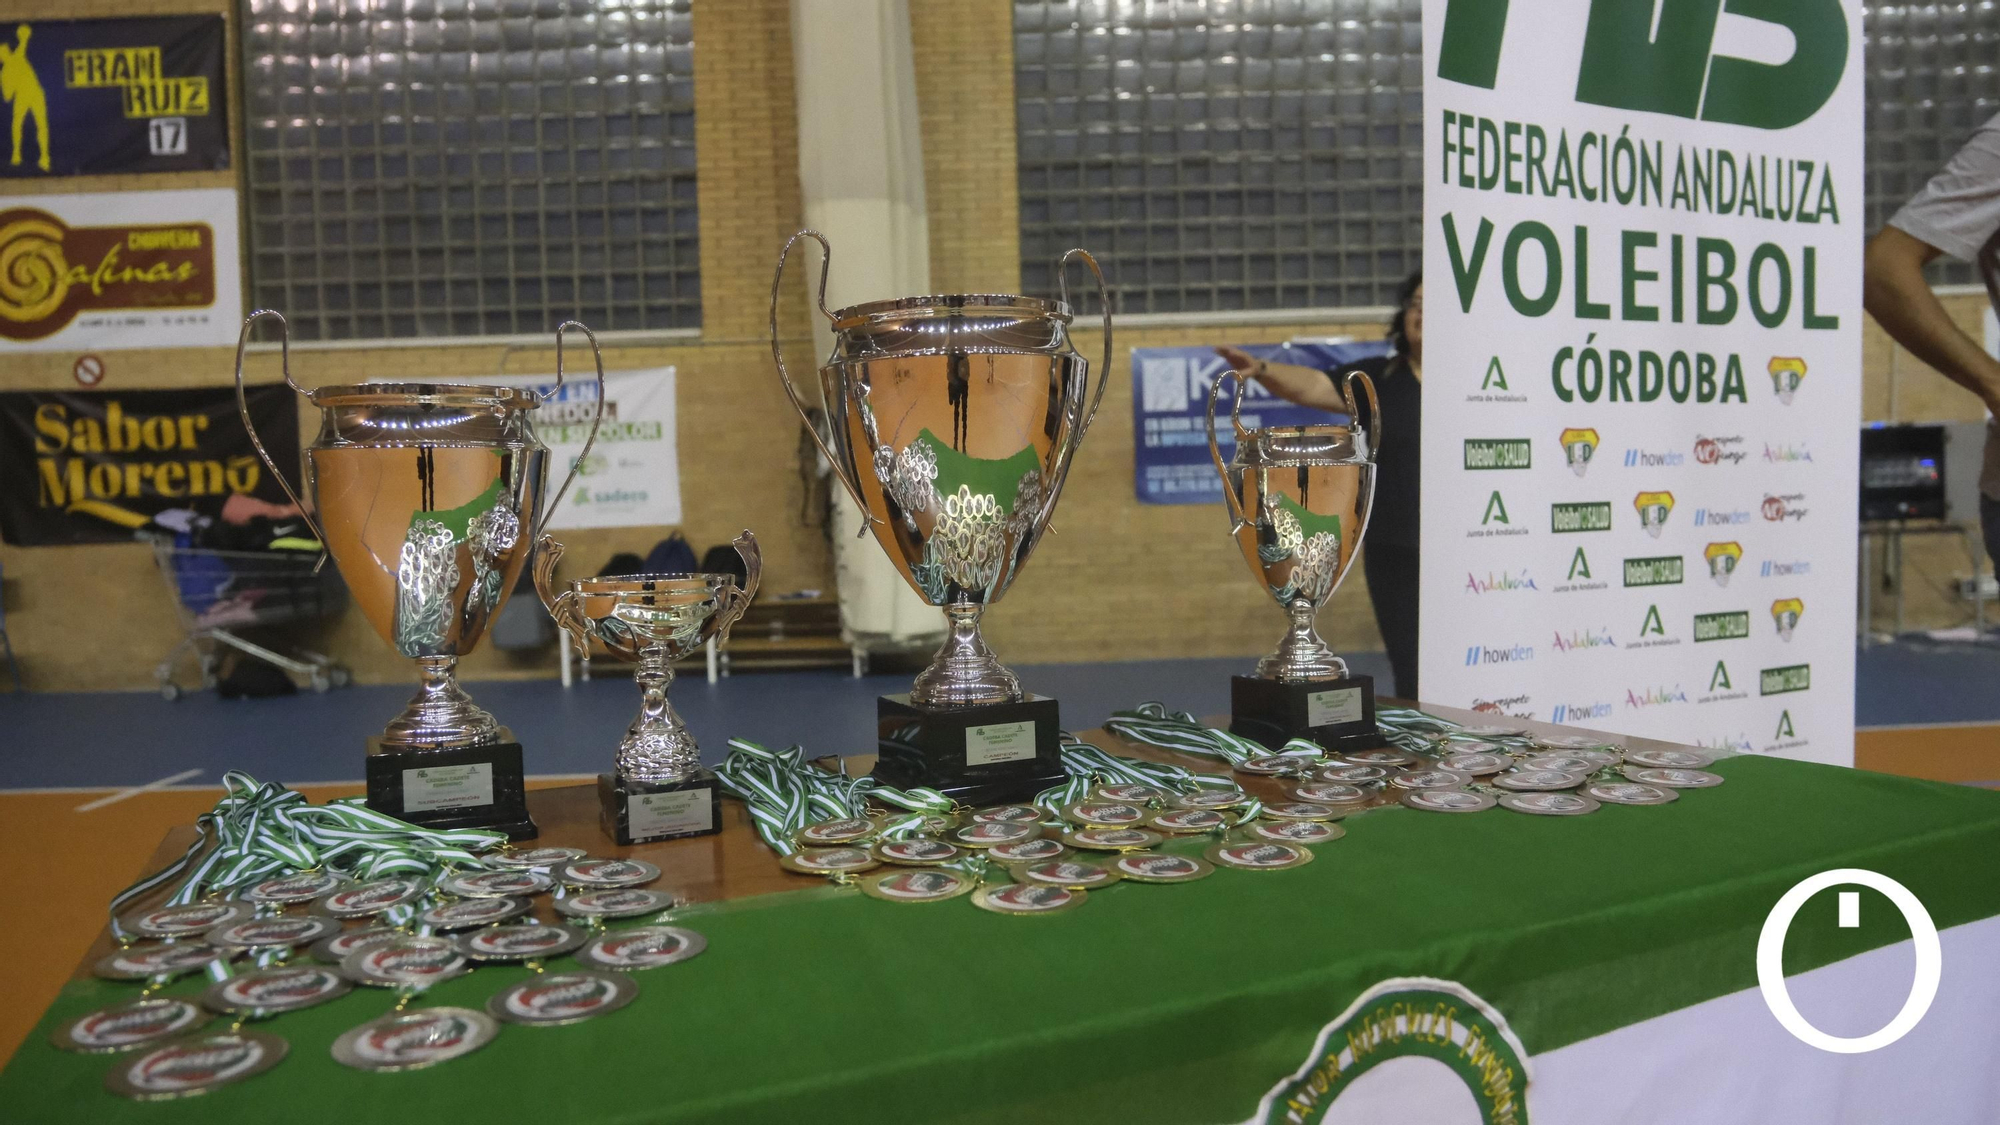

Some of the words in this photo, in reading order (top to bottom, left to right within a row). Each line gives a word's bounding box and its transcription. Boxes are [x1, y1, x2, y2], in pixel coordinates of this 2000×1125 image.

[66, 50, 157, 83] FRAN
[125, 81, 204, 113] RUIZ
[154, 122, 182, 150] 17
[1442, 109, 1662, 207] FEDERACIÓN
[1671, 144, 1840, 225] ANDALUZA
[1441, 211, 1839, 330] VOLEIBOL
[1551, 332, 1748, 403] CÓRDOBA
[35, 400, 209, 454] Sabor
[1640, 449, 1684, 467] howden
[1707, 509, 1750, 526] howden
[1466, 529, 1485, 538] Junta
[1772, 560, 1811, 576] howden
[1483, 644, 1534, 664] howden
[1568, 702, 1613, 721] howden
